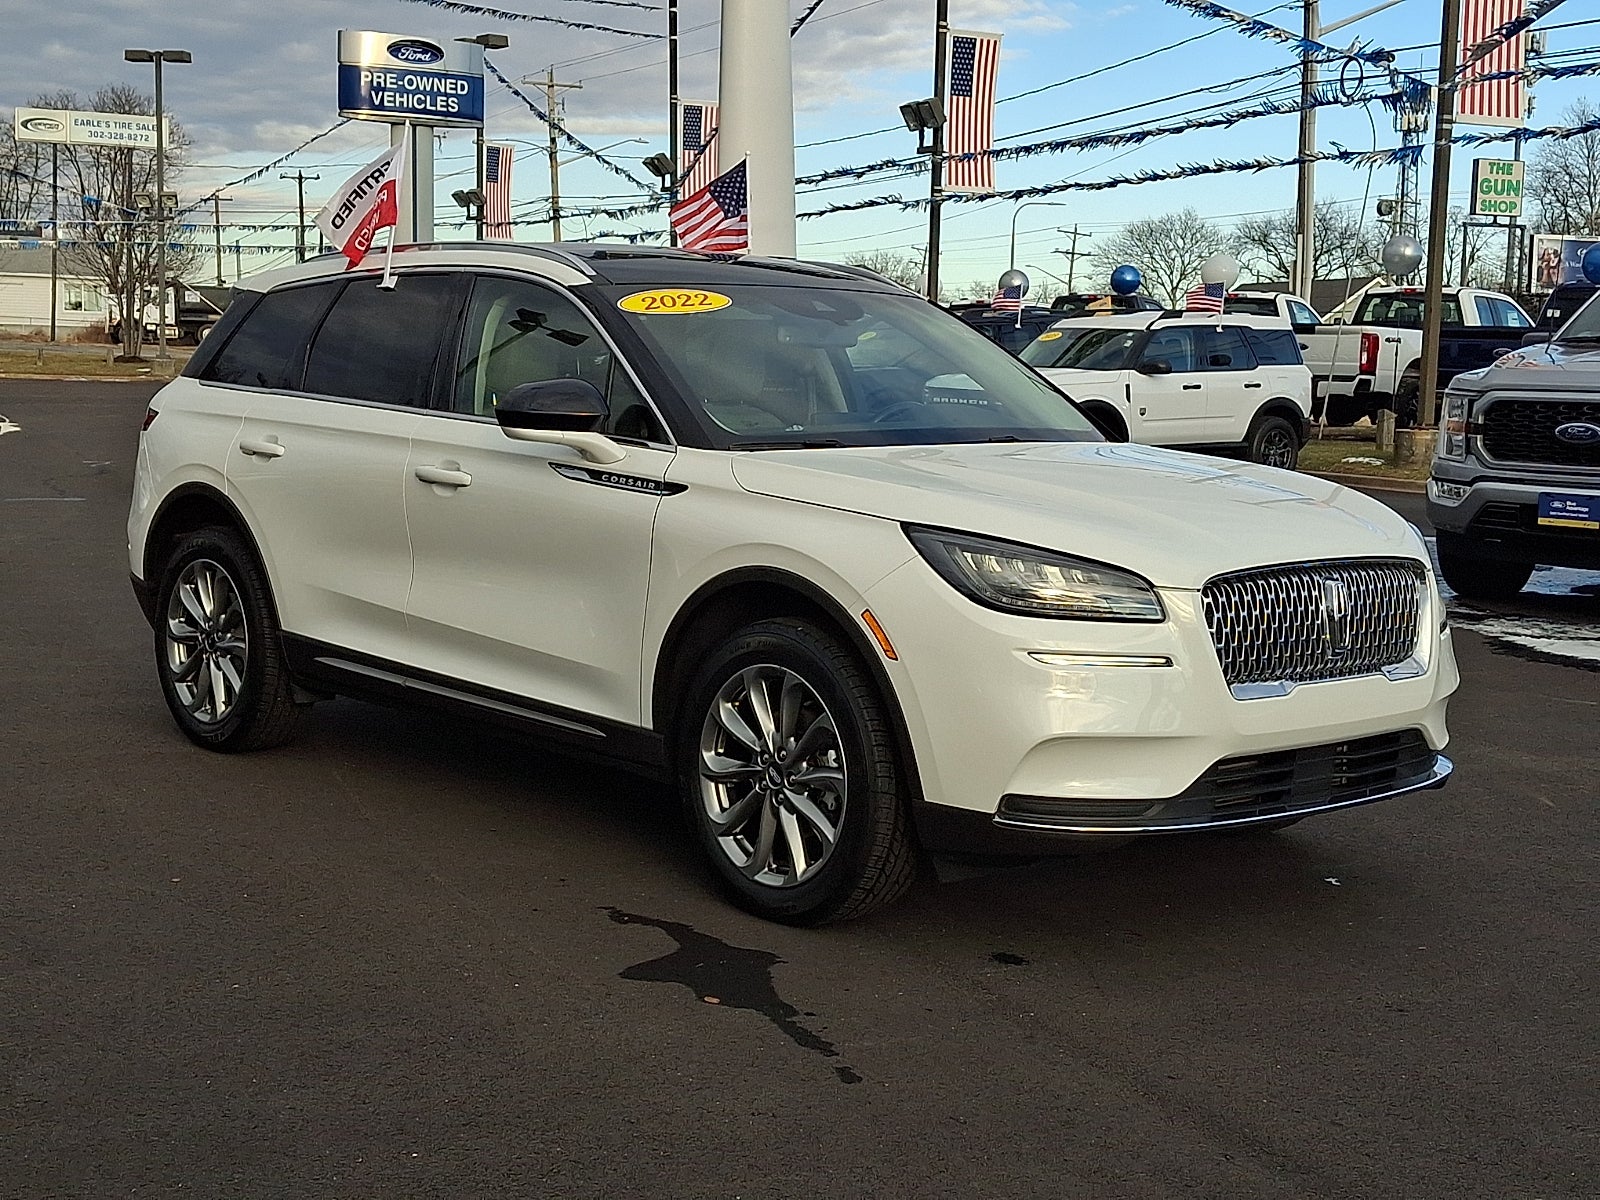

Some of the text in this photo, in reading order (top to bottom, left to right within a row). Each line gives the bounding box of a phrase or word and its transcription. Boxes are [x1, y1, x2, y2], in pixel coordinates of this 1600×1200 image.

[398, 46, 432, 62] Ford
[360, 71, 469, 95] PRE-OWNED
[371, 91, 459, 113] VEHICLES
[74, 118, 158, 132] EARLE'S TIRE SALE
[88, 130, 150, 142] 302-328-8272
[1488, 161, 1514, 176] THE
[1479, 178, 1520, 197] GUN
[1480, 199, 1518, 214] SHOP
[641, 293, 713, 311] 2022
[601, 474, 656, 489] CORSAIR
